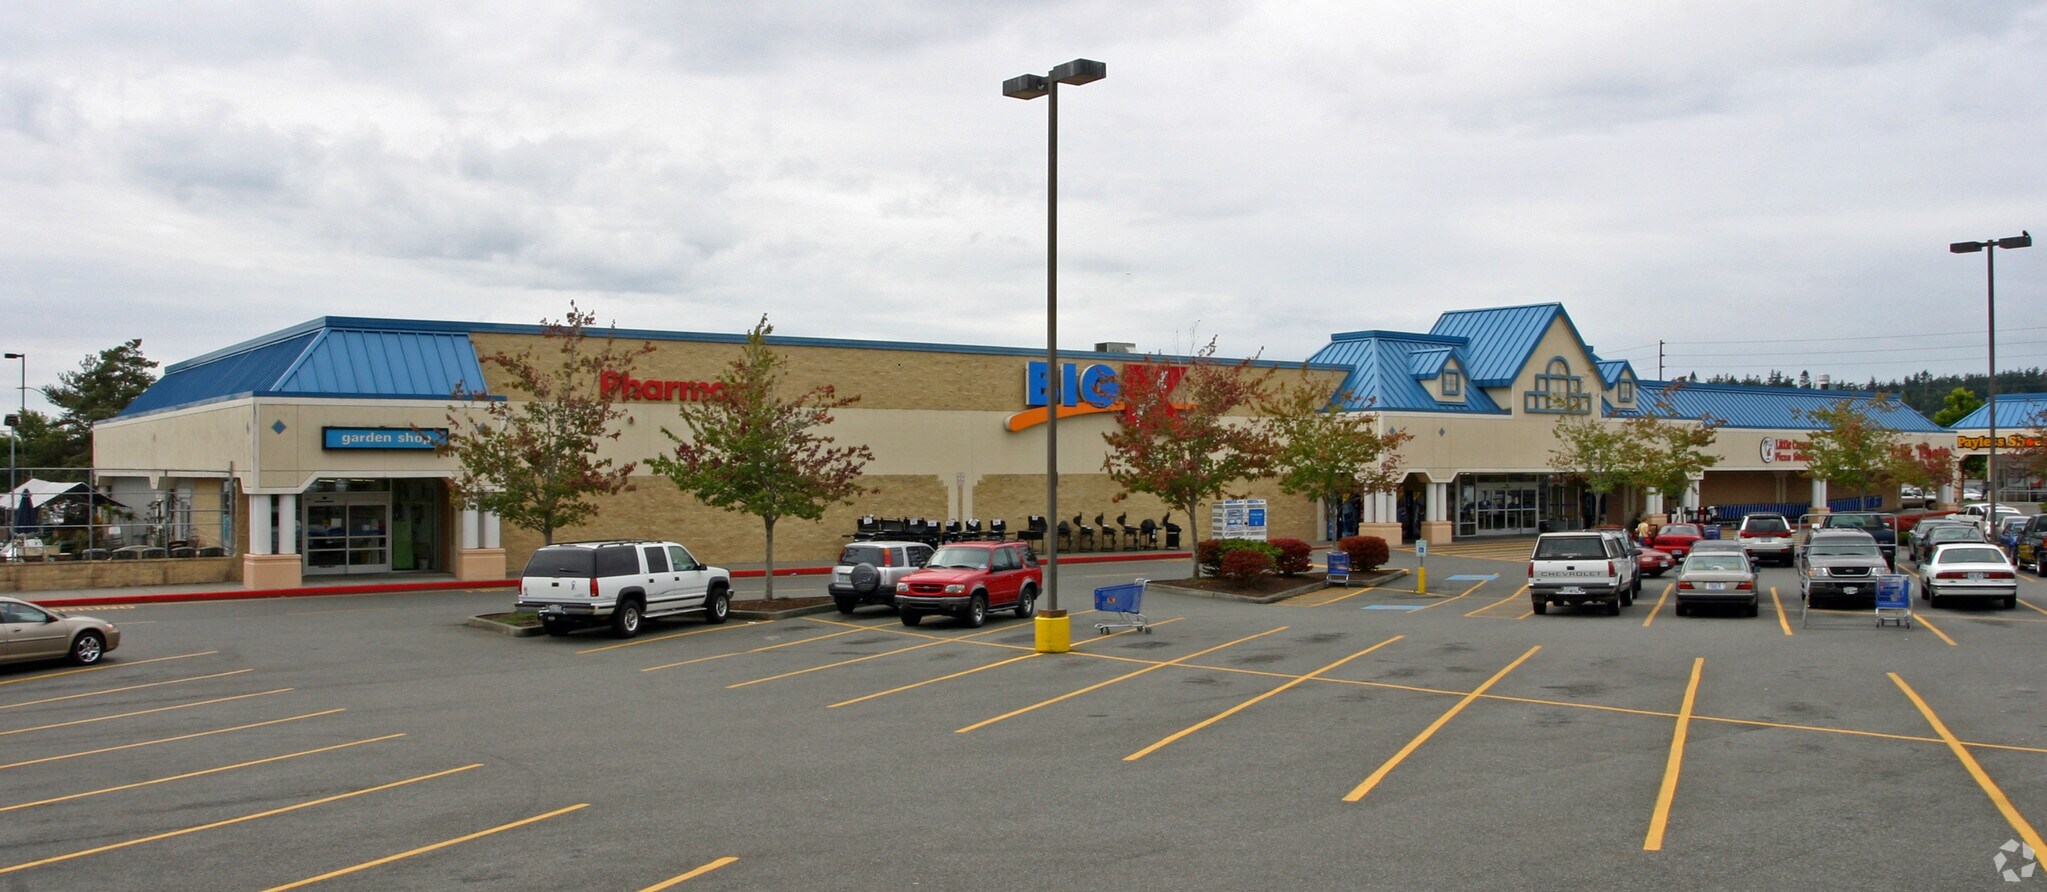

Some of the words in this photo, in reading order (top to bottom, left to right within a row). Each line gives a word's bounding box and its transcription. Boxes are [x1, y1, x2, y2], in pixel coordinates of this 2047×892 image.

[600, 370, 738, 402] Pharma
[1027, 361, 1119, 408] BIG
[342, 432, 392, 445] garden
[398, 433, 432, 445] shop
[1775, 439, 1792, 450] Little
